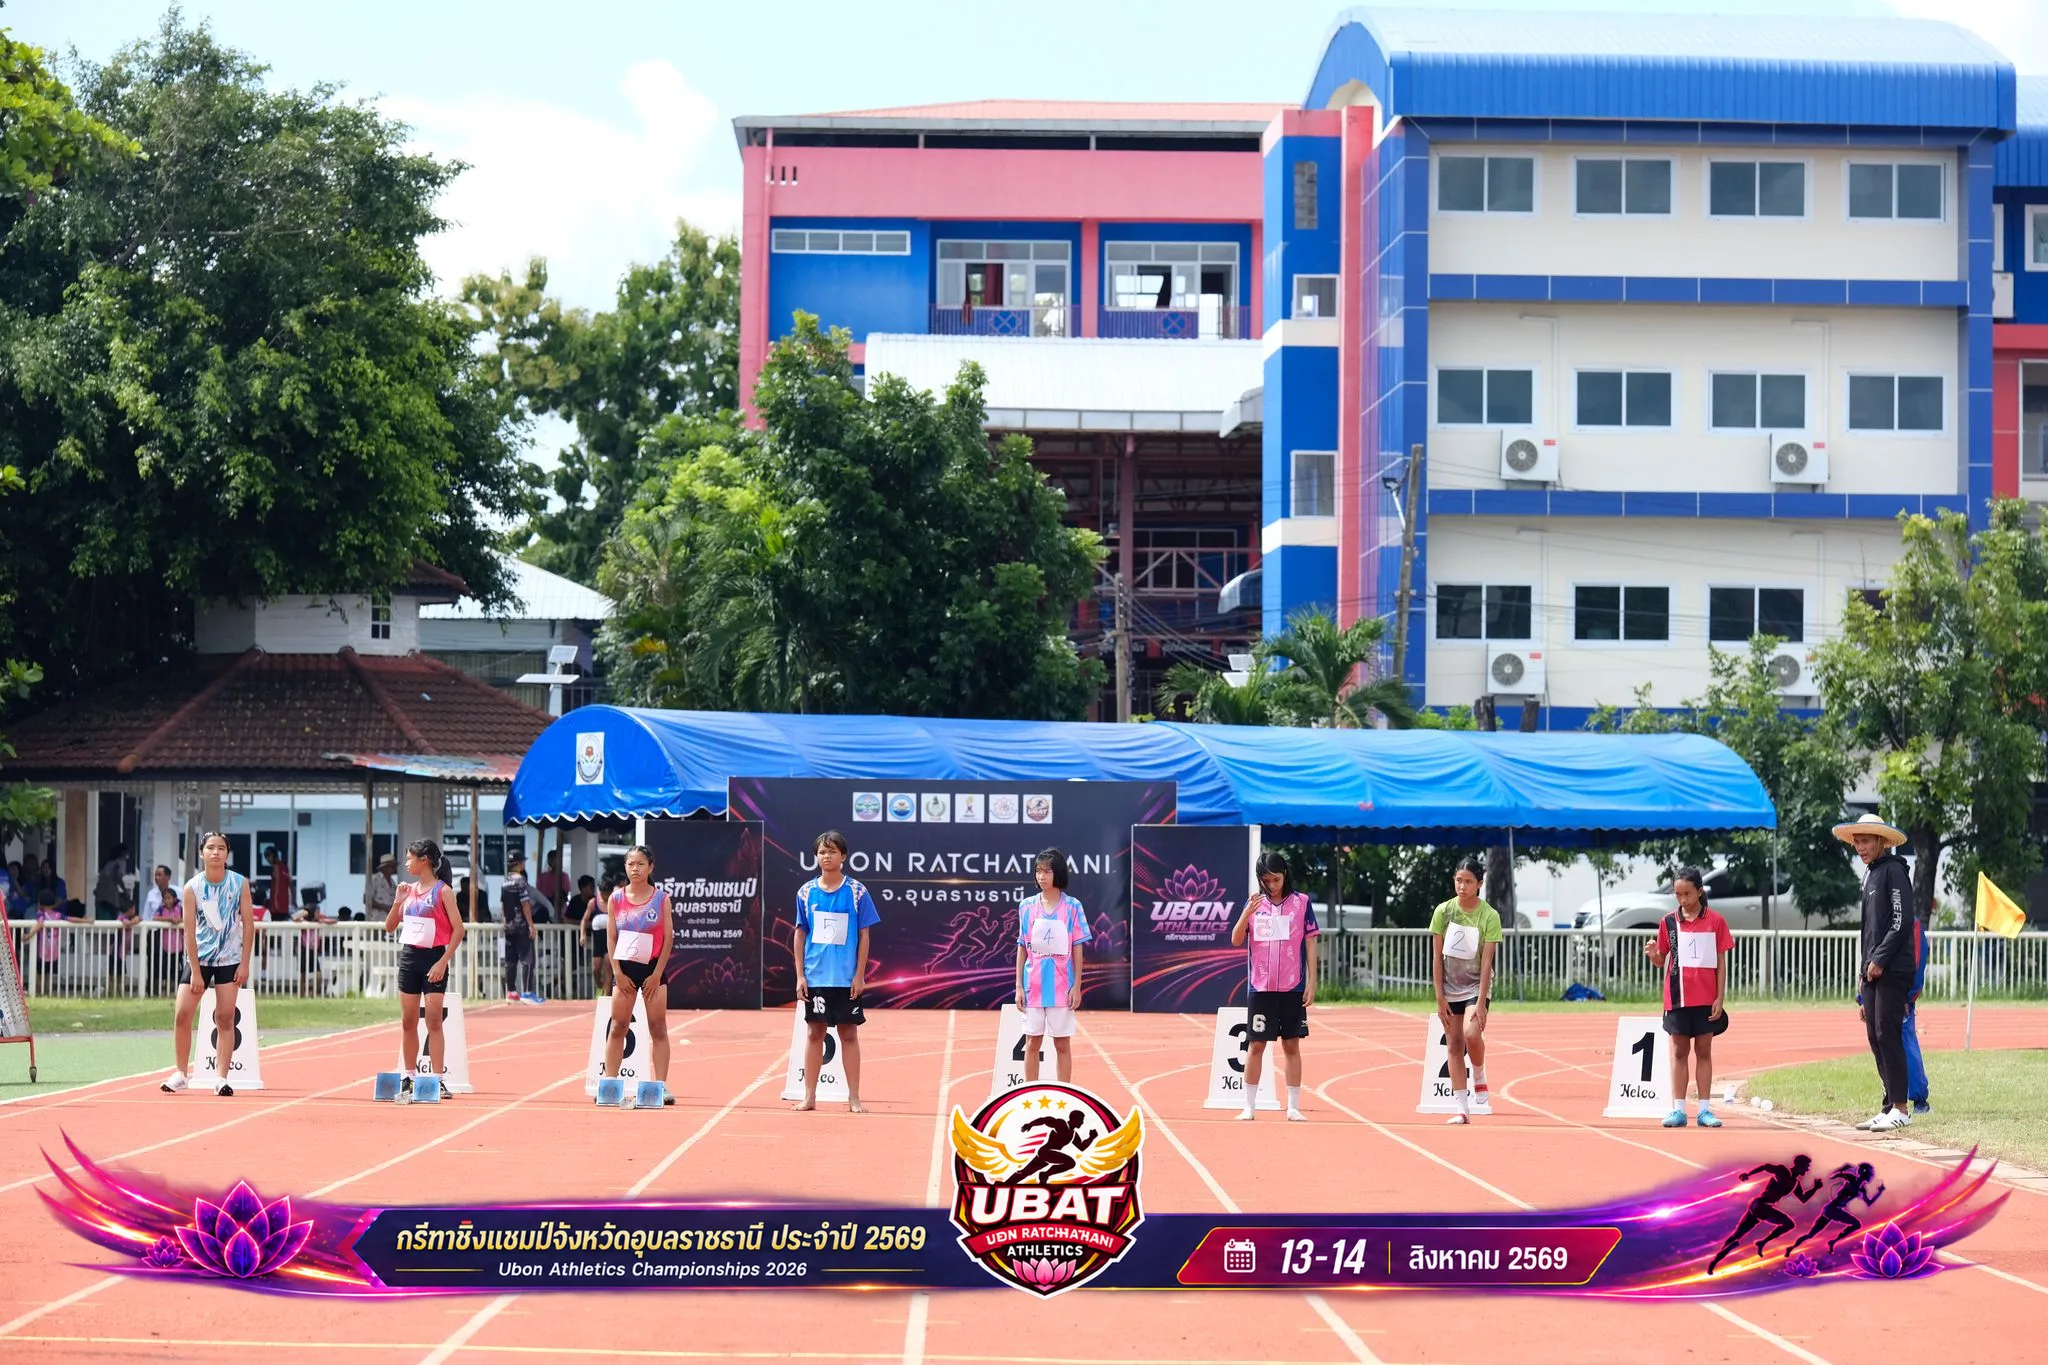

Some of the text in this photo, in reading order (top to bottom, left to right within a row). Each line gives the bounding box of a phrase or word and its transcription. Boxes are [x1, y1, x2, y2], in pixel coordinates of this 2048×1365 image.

[800, 852, 1110, 874] UON RATCHATANI
[882, 886, 1025, 906] จ.อุบลราชธานี
[1892, 888, 1902, 911] NIKE
[671, 899, 742, 917] .อุบลราชธานี
[1150, 901, 1235, 921] UBON
[723, 929, 743, 938] 2569
[823, 918, 838, 940] 5
[1043, 928, 1056, 944] 4
[1152, 921, 1231, 932] ATHLETICS
[626, 937, 640, 957] 6
[1451, 931, 1467, 952] 2
[1688, 938, 1701, 959] 1
[812, 996, 826, 1014] 16
[1252, 1014, 1267, 1032] 6
[205, 1056, 243, 1070] Nco
[1631, 1032, 1655, 1082] 1
[1222, 1076, 1243, 1090] Nel
[1620, 1083, 1656, 1099] Nelco
